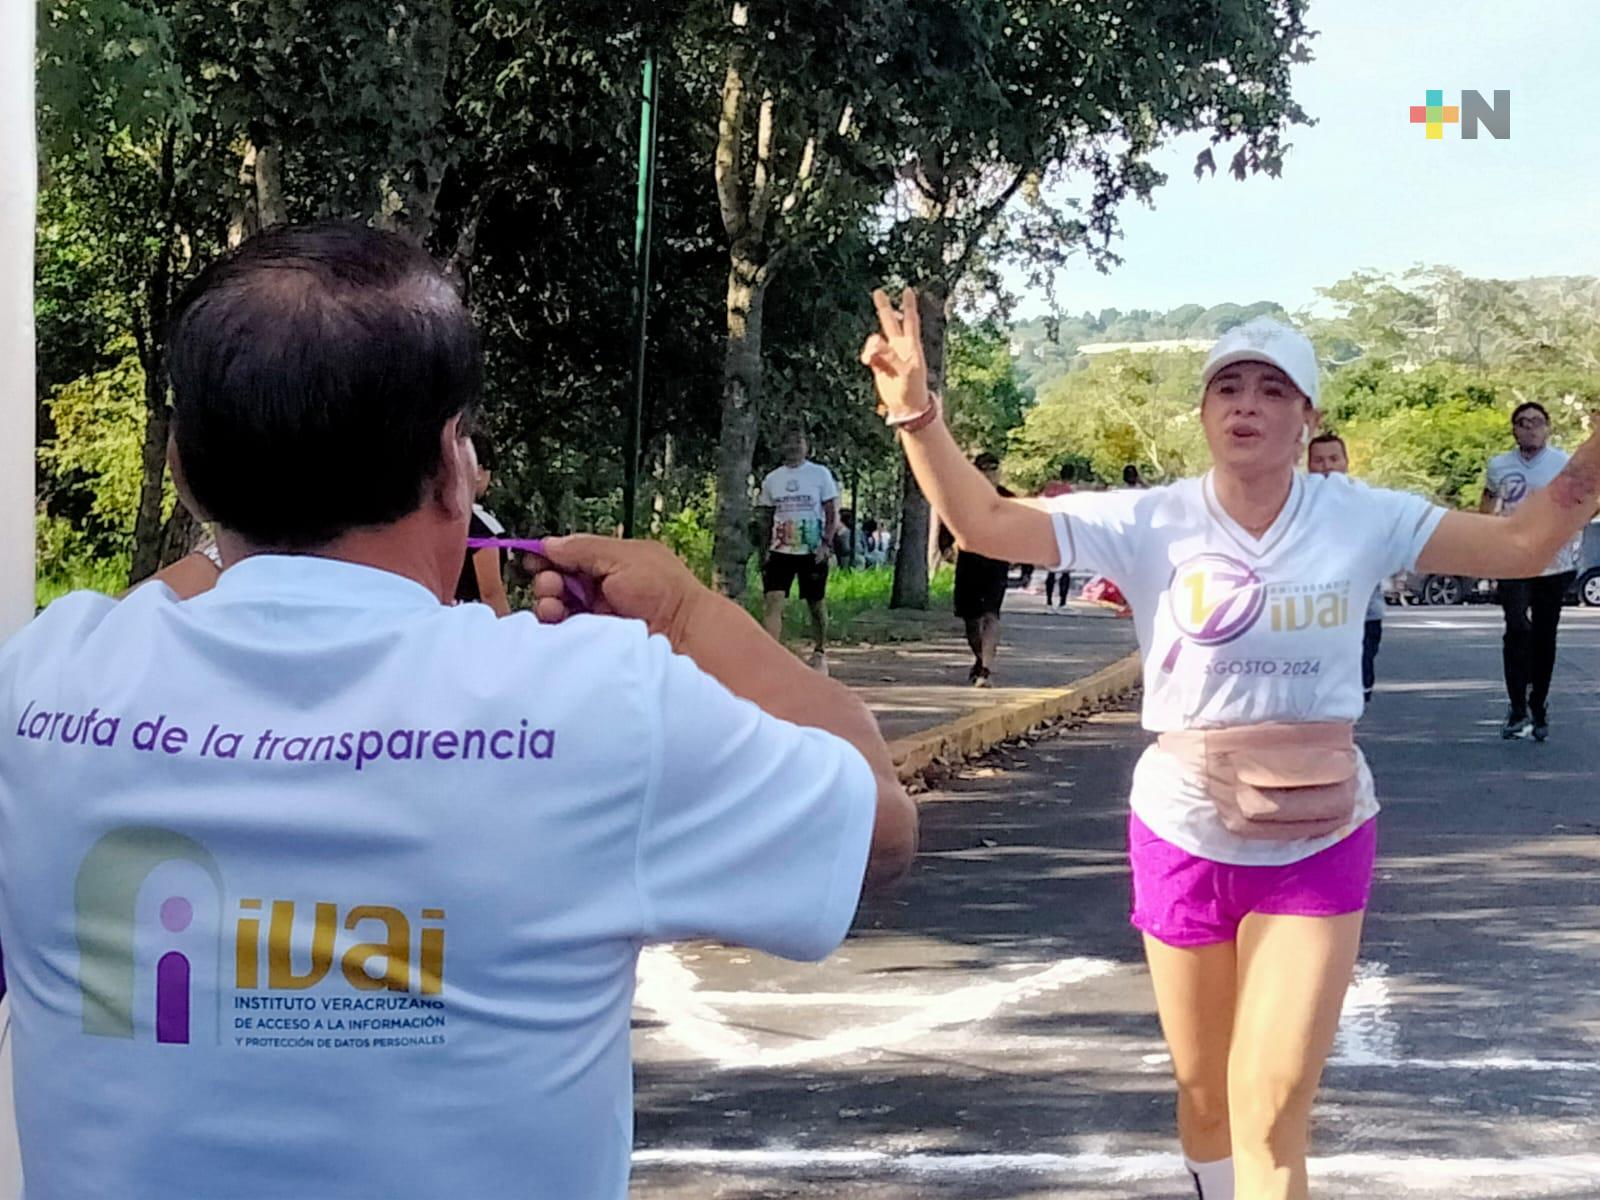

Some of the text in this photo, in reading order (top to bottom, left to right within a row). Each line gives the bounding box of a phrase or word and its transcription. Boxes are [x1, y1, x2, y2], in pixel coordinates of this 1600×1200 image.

[1281, 660, 1321, 675] 2024
[132, 714, 189, 755] de
[200, 724, 244, 759] la
[253, 718, 556, 771] transparencia
[234, 996, 445, 1011] INSTITUTO VERACRUZANO
[234, 1014, 445, 1031] DE ACCESO A LA INFORMACIÓN
[235, 1035, 445, 1048] Y PROTECCIÓN DE DATOS PERSONALES
